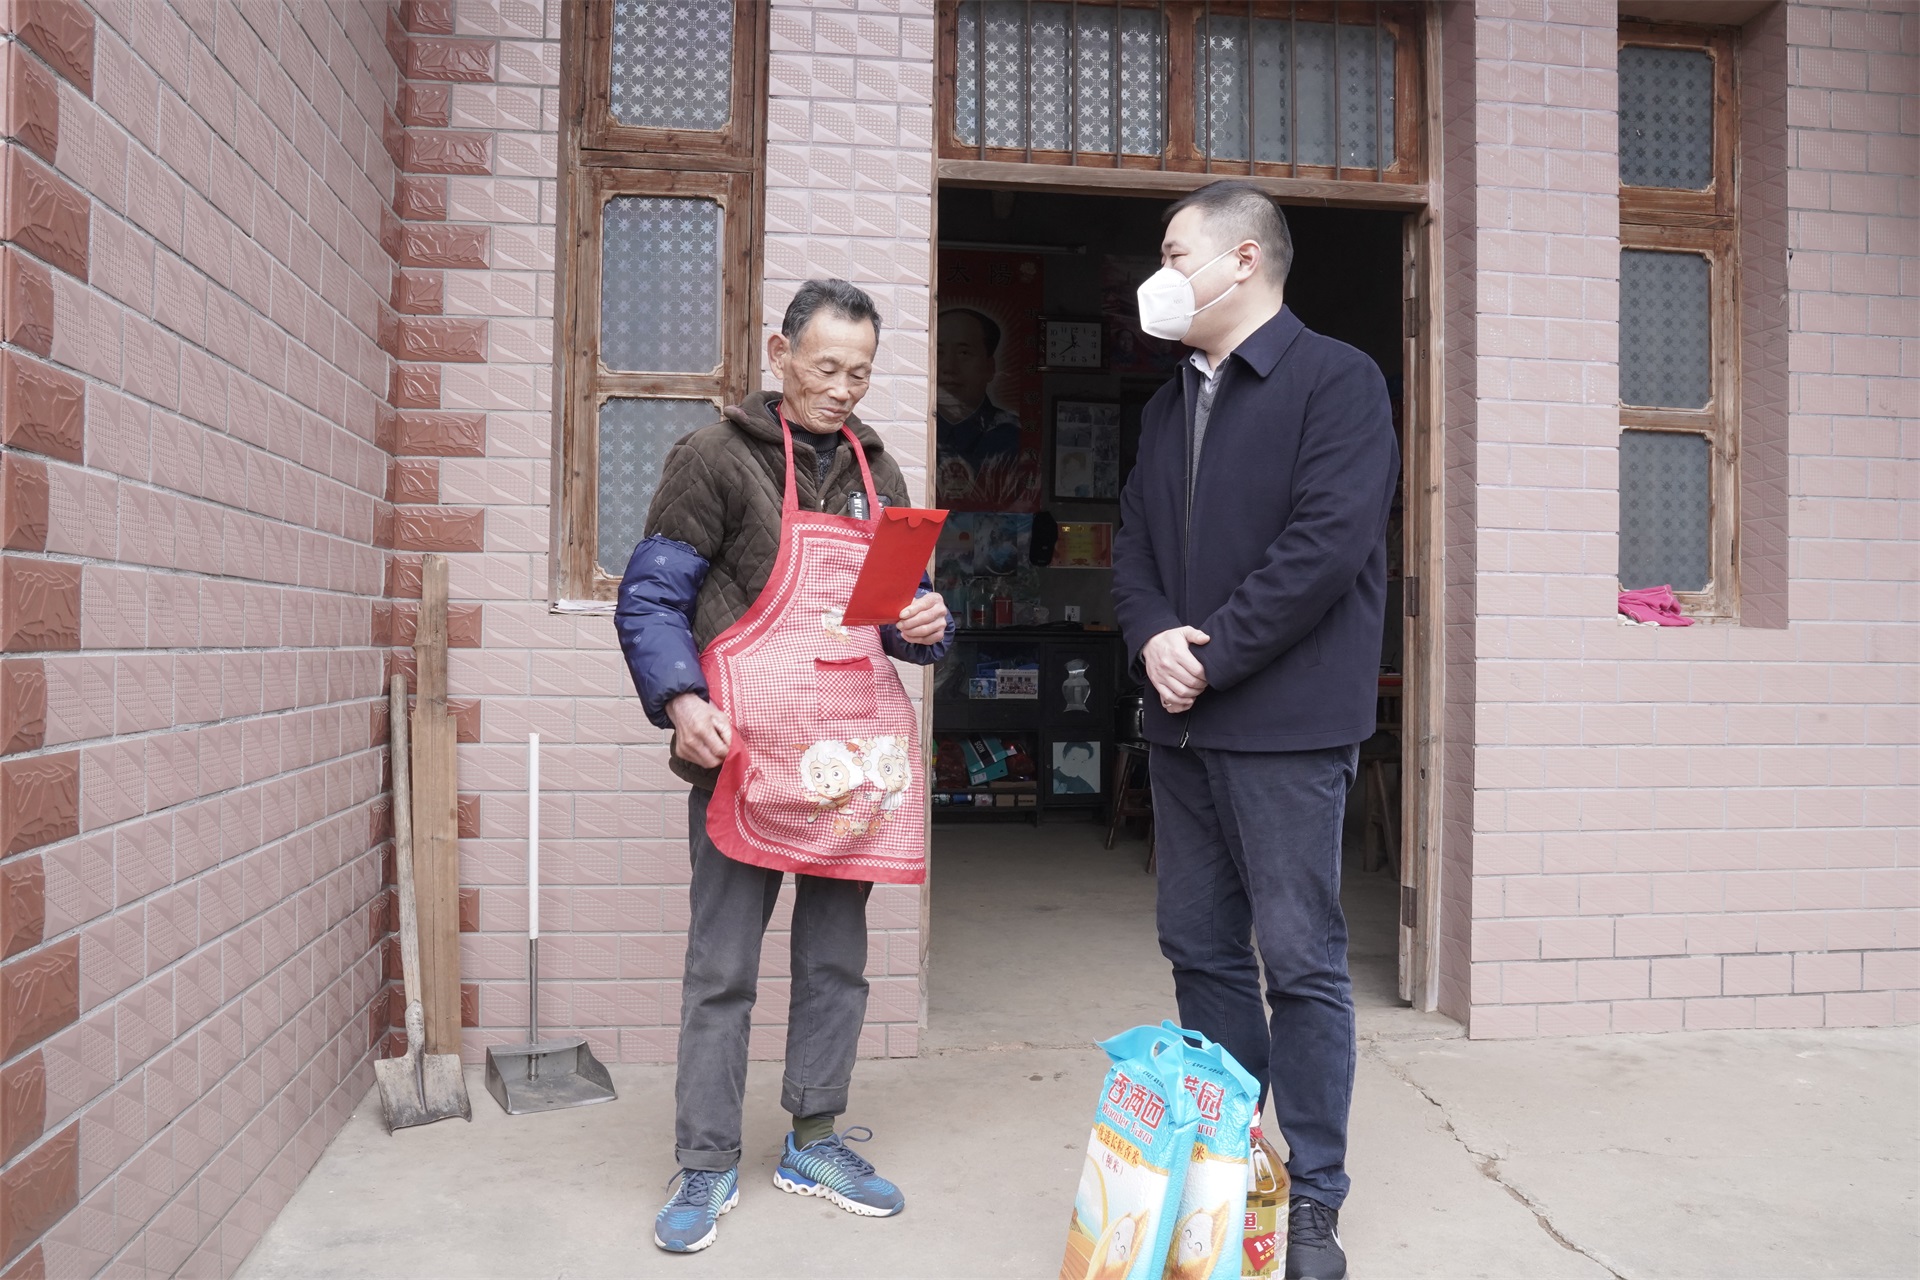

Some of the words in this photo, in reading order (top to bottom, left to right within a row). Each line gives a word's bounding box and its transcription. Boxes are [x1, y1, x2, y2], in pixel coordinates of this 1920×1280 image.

[854, 499, 862, 508] MY
[1102, 1102, 1130, 1128] Wonder
[1130, 1121, 1153, 1145] Farm
